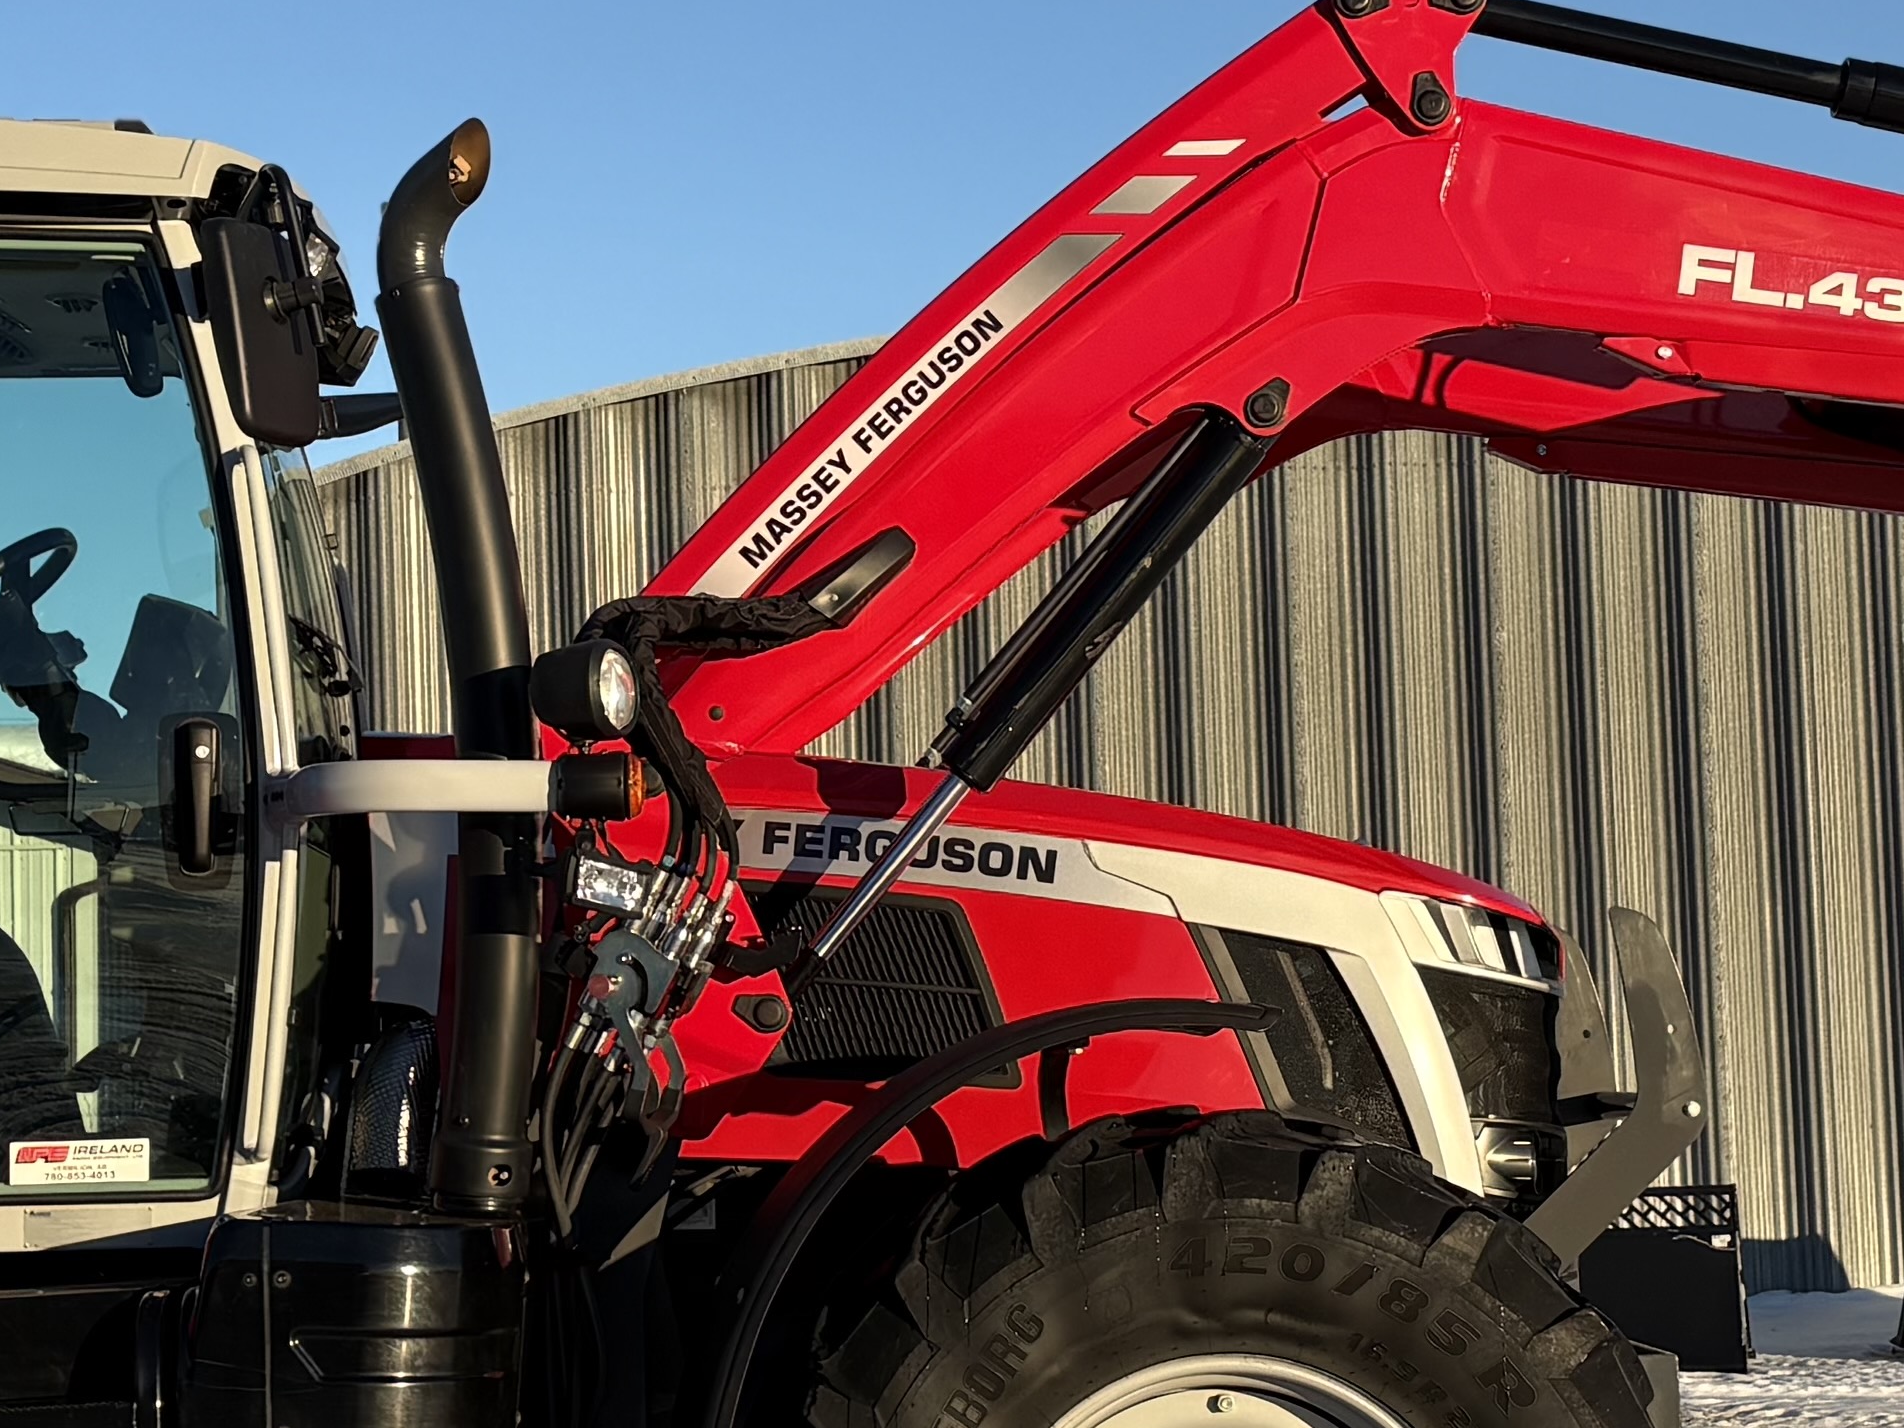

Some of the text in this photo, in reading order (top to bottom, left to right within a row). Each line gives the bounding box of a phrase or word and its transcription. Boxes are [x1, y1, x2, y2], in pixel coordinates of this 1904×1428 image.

[738, 309, 1004, 569] MASSEY FERGUSON
[44, 1171, 116, 1181] 780-853-4013
[73, 1144, 144, 1155] IRELAND
[1169, 1236, 1483, 1357] 420/85
